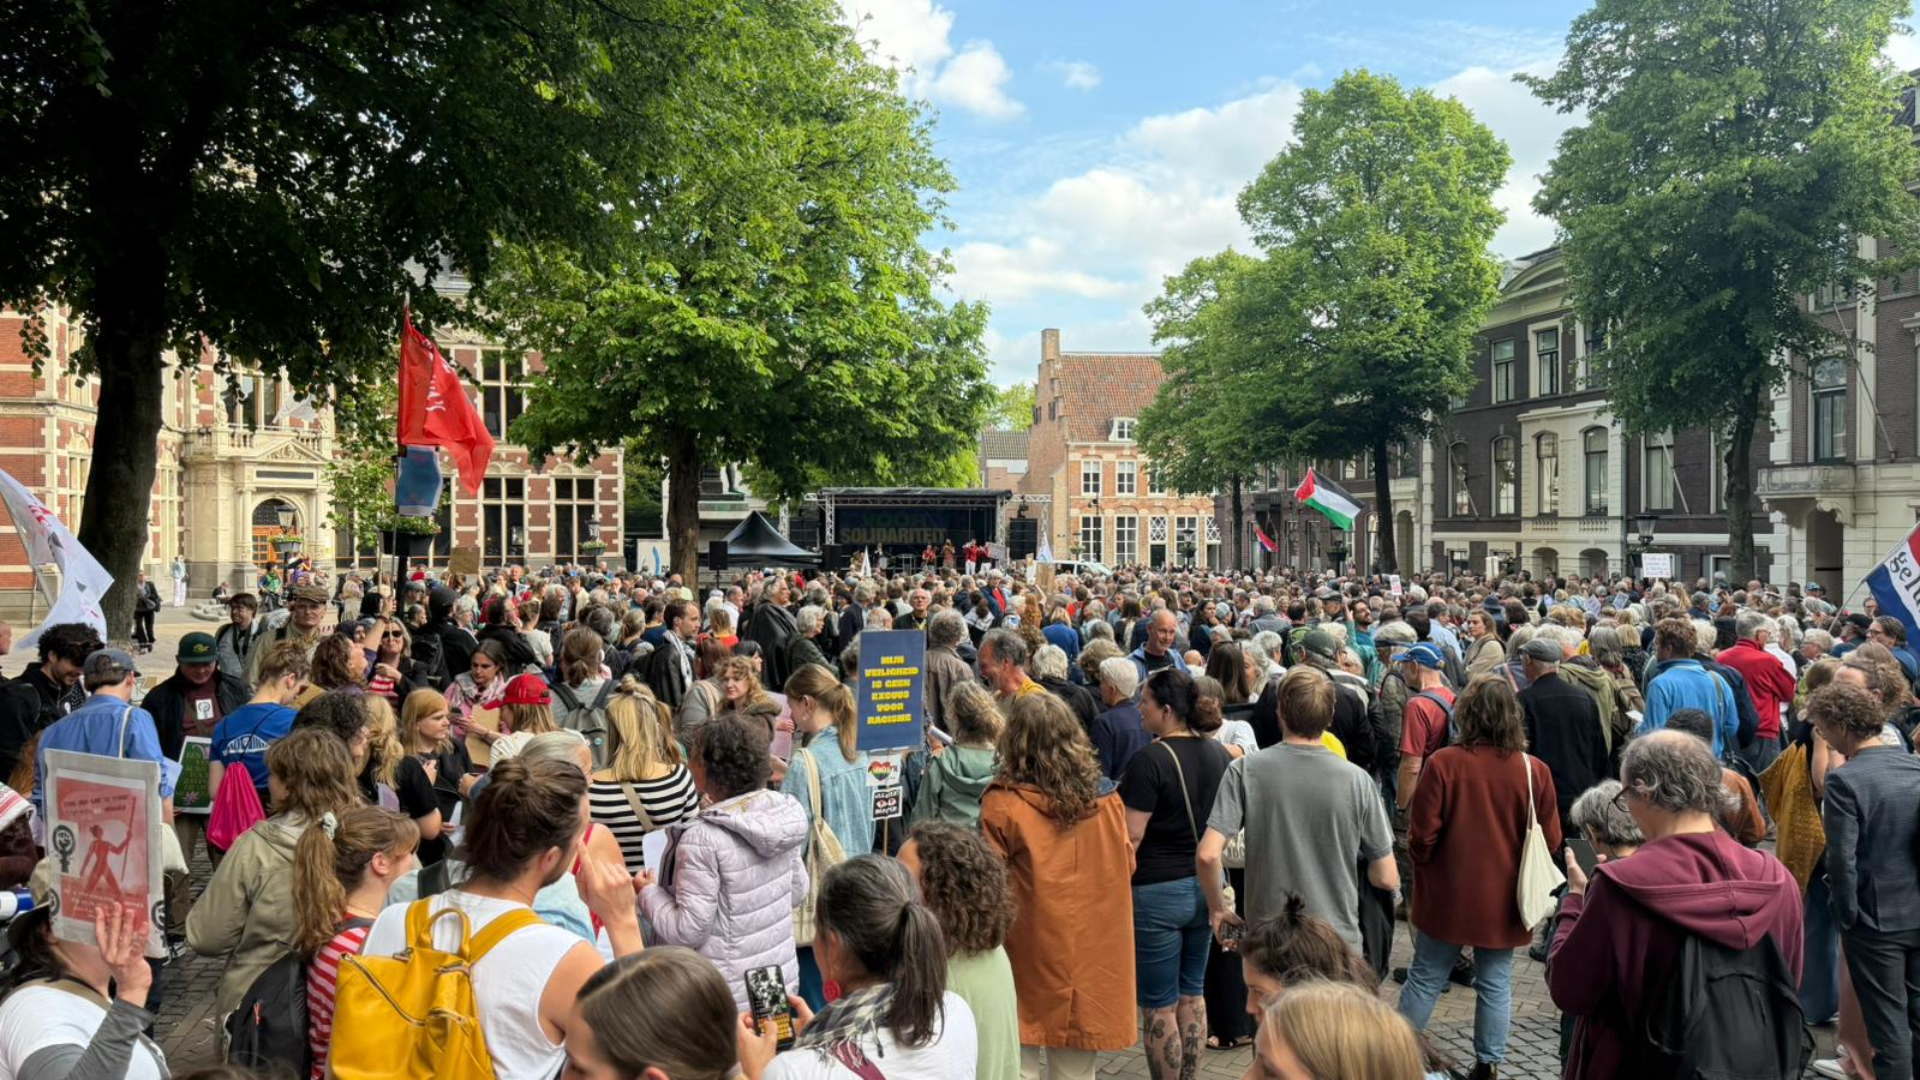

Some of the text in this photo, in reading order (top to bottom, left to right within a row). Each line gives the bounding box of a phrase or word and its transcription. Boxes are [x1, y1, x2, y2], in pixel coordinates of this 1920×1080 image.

[841, 528, 947, 544] SOLIDARITEIT
[882, 656, 904, 665] MIJN
[865, 667, 919, 678] VEILIGHEID
[872, 679, 911, 689] IS GEEN
[872, 691, 910, 701] EXCUUS
[877, 703, 904, 712] VOOR
[867, 714, 912, 724] RACISME
